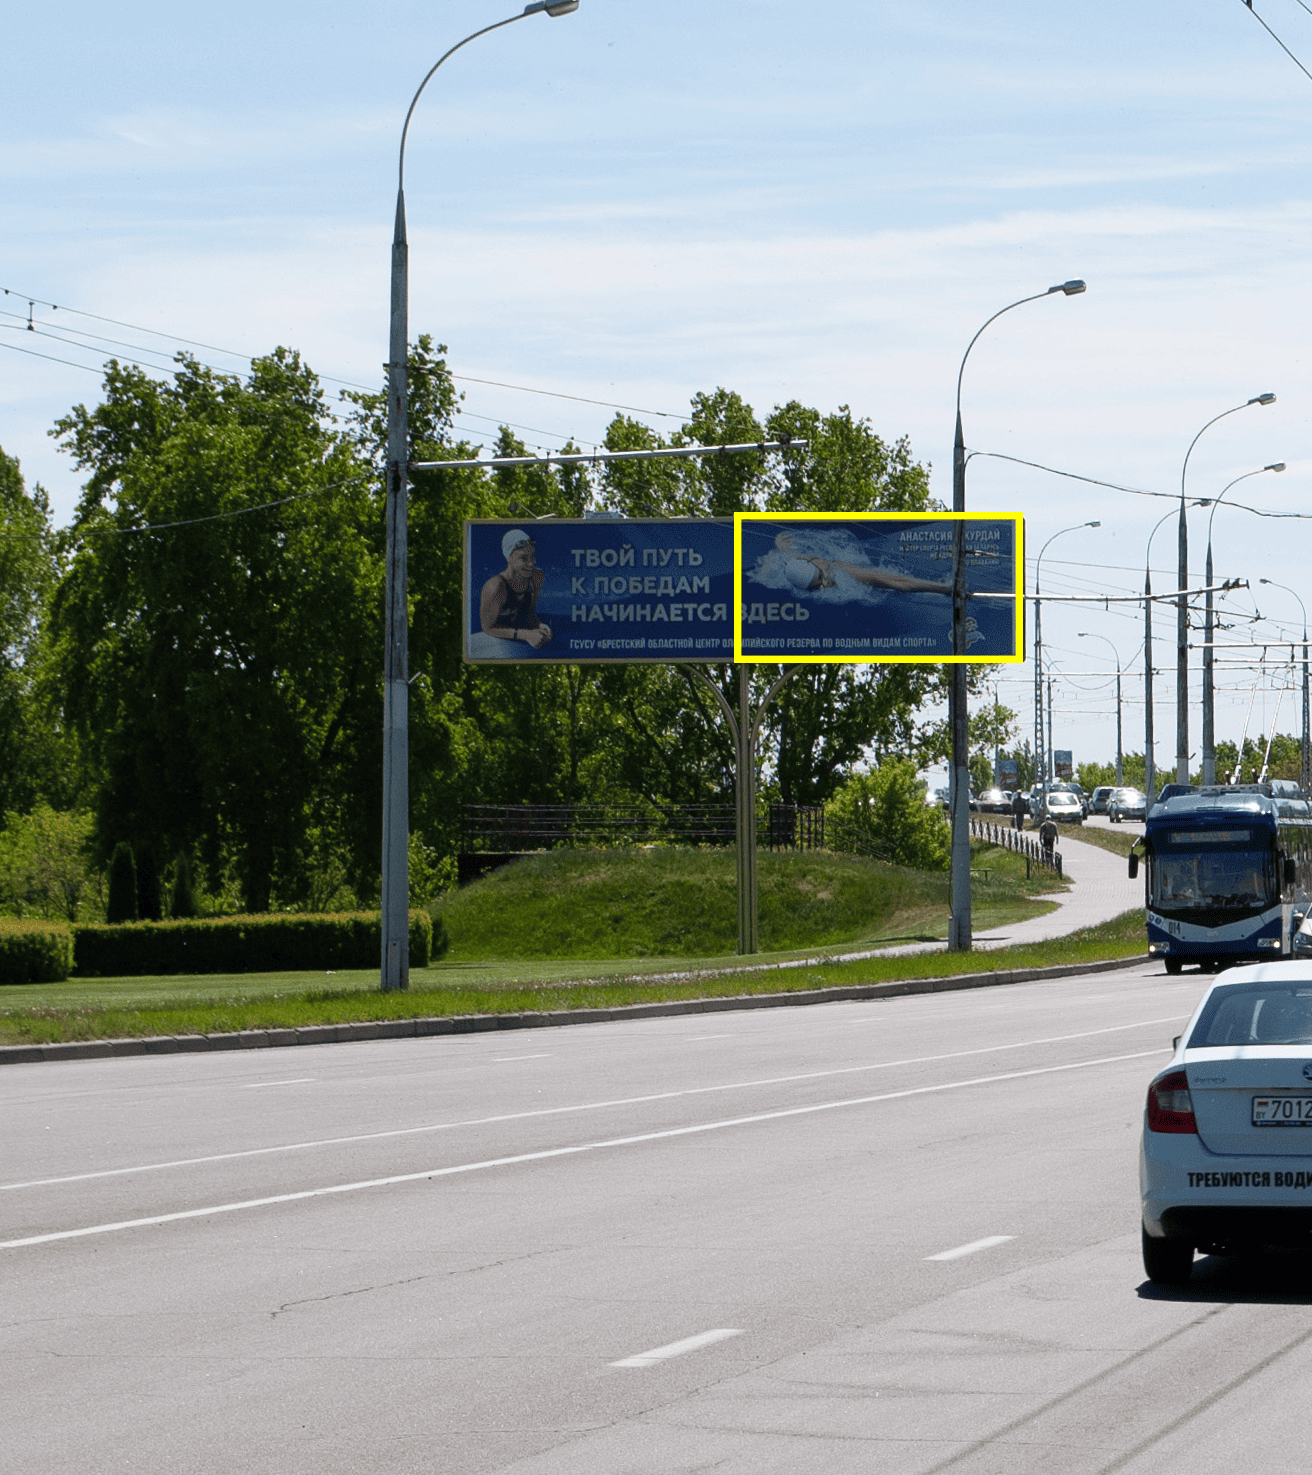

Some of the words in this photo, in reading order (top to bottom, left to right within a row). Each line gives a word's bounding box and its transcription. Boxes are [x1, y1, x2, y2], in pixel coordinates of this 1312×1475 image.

[900, 531, 953, 542] АНАСТАСИЯ
[964, 528, 1000, 543] КУРДАЙ
[571, 544, 635, 567] ТВОЙ
[643, 548, 703, 567] ПУТЬ
[571, 576, 586, 595] К
[594, 576, 710, 597] ПОБЕДАМ
[571, 603, 727, 622] НАЧИНАЕТСЯ
[737, 603, 810, 624] ЗДЕСЬ
[570, 637, 596, 650] ГСУСУ
[648, 637, 694, 650] ОБЛАСТНОЙ
[696, 637, 721, 650] ЦЕНТР
[722, 637, 785, 648] ОЛМПИЙСКОГО
[787, 638, 821, 648] РЕЗЕРВА
[823, 638, 833, 648] ПО
[835, 638, 871, 649] ВОДНЫМ
[873, 638, 901, 648] ВИДАМ
[902, 637, 937, 648] СПОРТА»
[1168, 921, 1181, 935] 014
[1255, 1111, 1266, 1120] BY
[1187, 1171, 1271, 1189] ТРЕБУЮТСЯ
